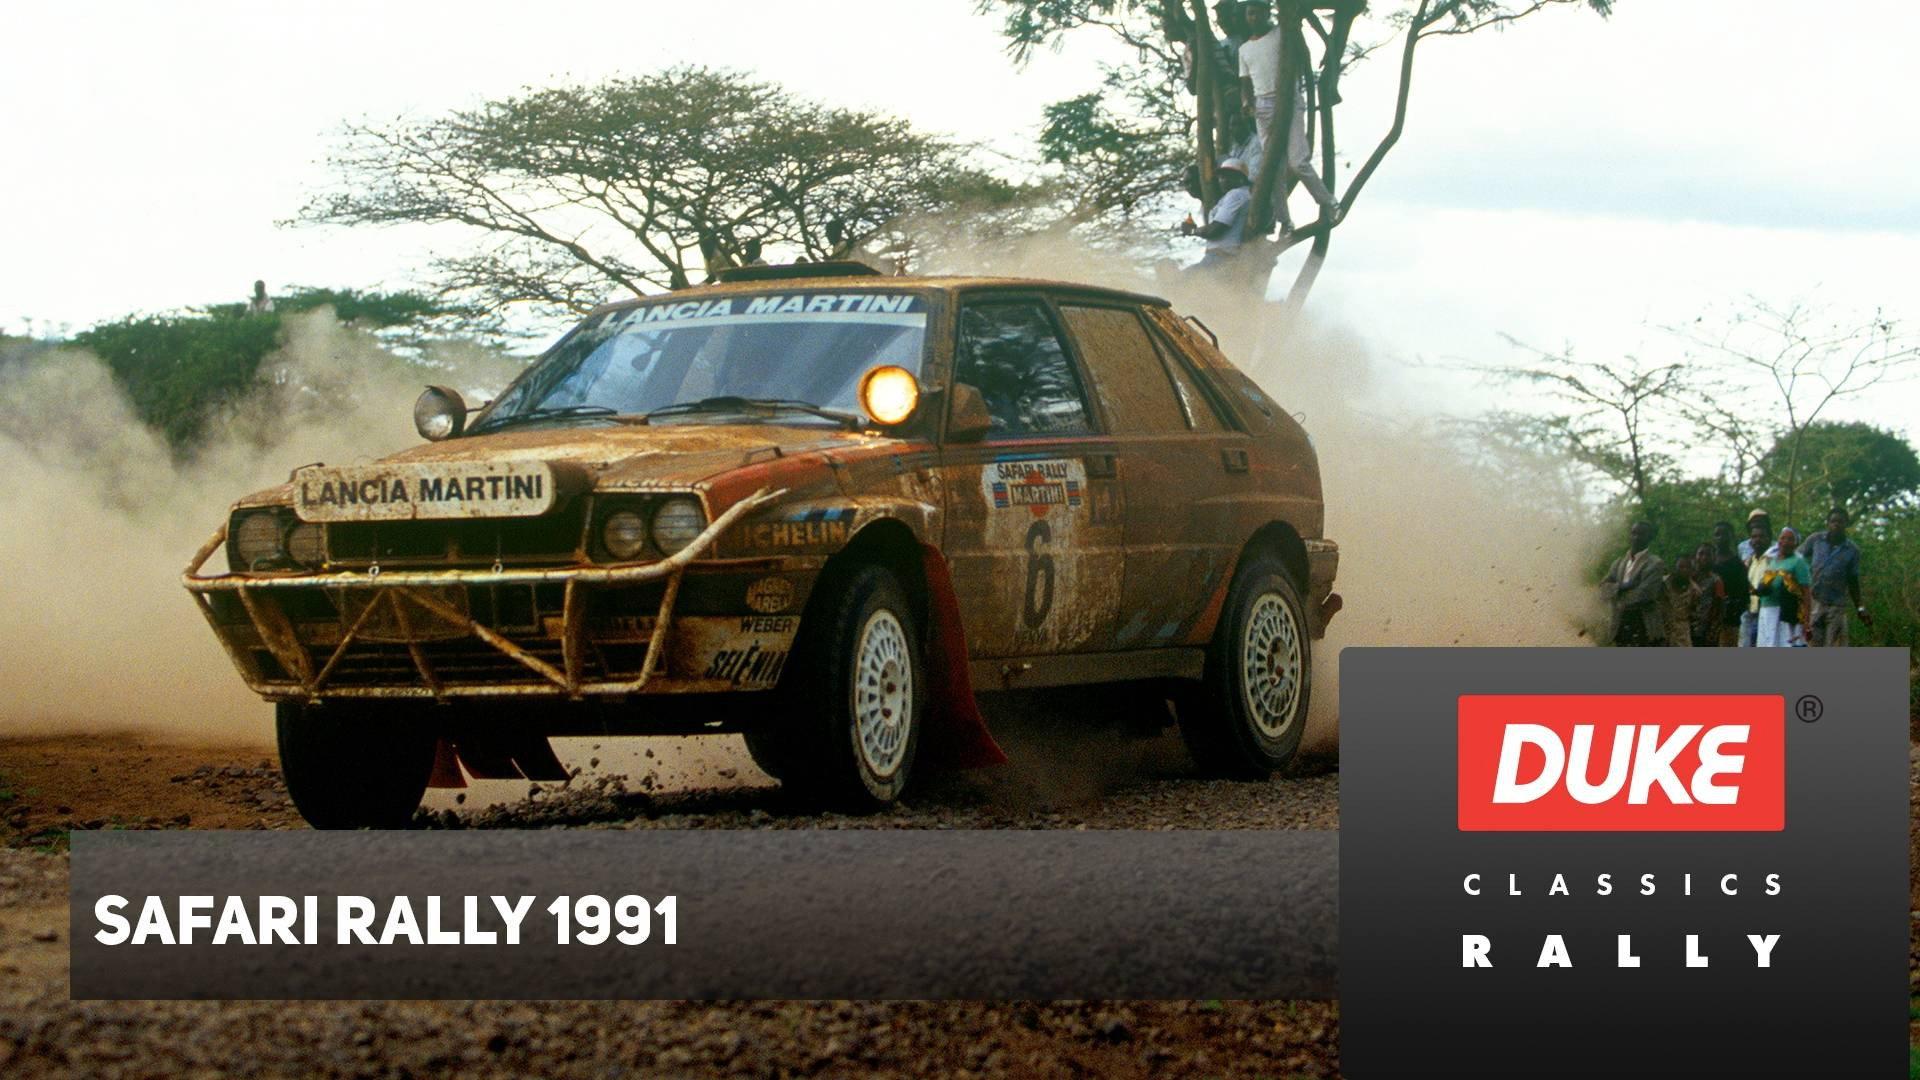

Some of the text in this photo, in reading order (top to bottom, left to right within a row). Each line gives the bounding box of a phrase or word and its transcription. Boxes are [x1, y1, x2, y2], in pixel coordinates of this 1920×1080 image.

[600, 295, 914, 328] LANCIA MARTINI
[1038, 463, 1068, 478] RALLY
[302, 474, 543, 505] LANCIA MARTINI
[1013, 485, 1063, 502] MARTINI
[728, 521, 846, 546] ICHELIN
[1024, 519, 1055, 630] 6
[740, 617, 792, 633] WEBER
